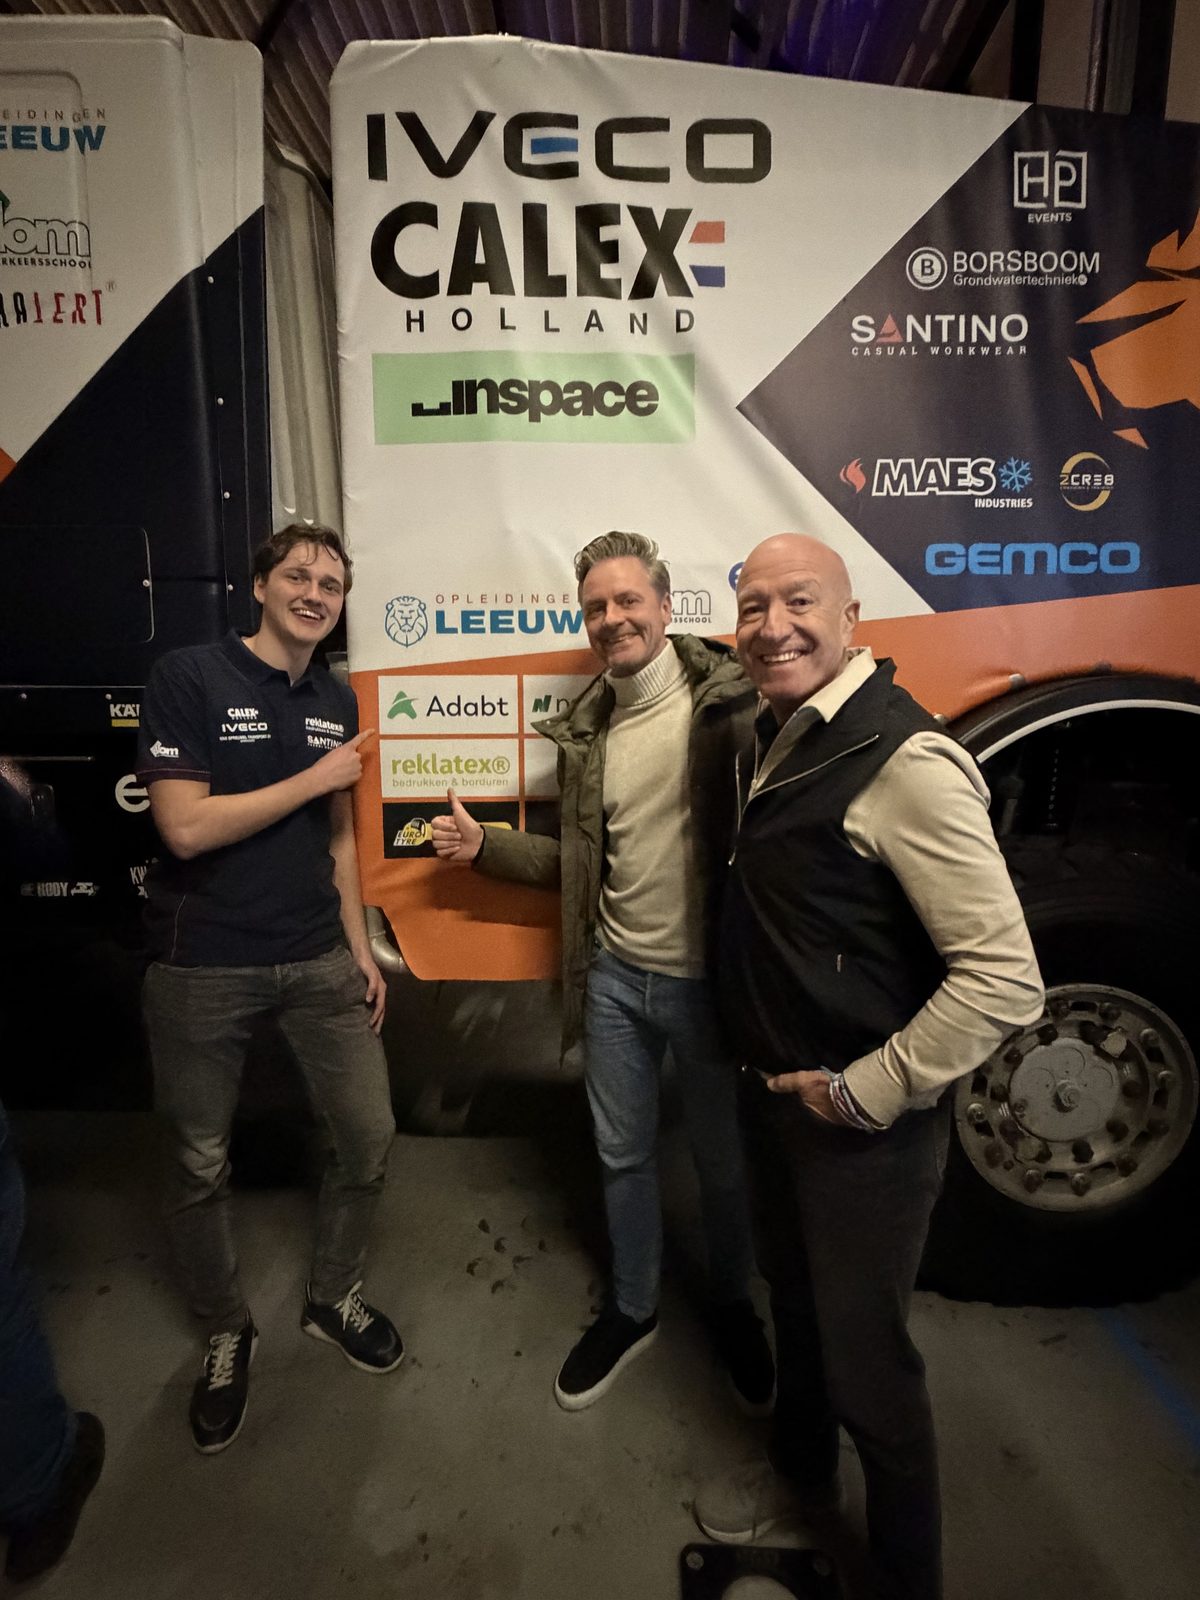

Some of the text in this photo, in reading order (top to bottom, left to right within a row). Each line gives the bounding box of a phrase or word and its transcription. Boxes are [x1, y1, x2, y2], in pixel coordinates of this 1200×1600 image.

[2, 108, 105, 123] EIDINGEN
[367, 110, 772, 184] IVECO
[1027, 212, 1073, 223] EVENTS
[0, 216, 92, 258] om
[371, 201, 694, 300] CALEX
[953, 251, 1100, 274] BORSBOOM
[953, 274, 1078, 286] Grondwatertechniek
[406, 308, 695, 335] HOLLAND
[851, 313, 1029, 343] SANTINO
[852, 346, 1027, 356] CASUAL WORKWEAR
[872, 457, 997, 496] MAES
[974, 498, 1033, 508] INDUSTRIES
[925, 541, 1141, 576] GEMCO
[435, 593, 580, 604] OPLEIDINGE
[435, 609, 583, 634] LEEUW
[671, 616, 712, 624] SSCHOOL
[426, 695, 509, 717] Adabt
[221, 722, 268, 733] IVECO
[392, 778, 509, 788] bedrukken & borduren
